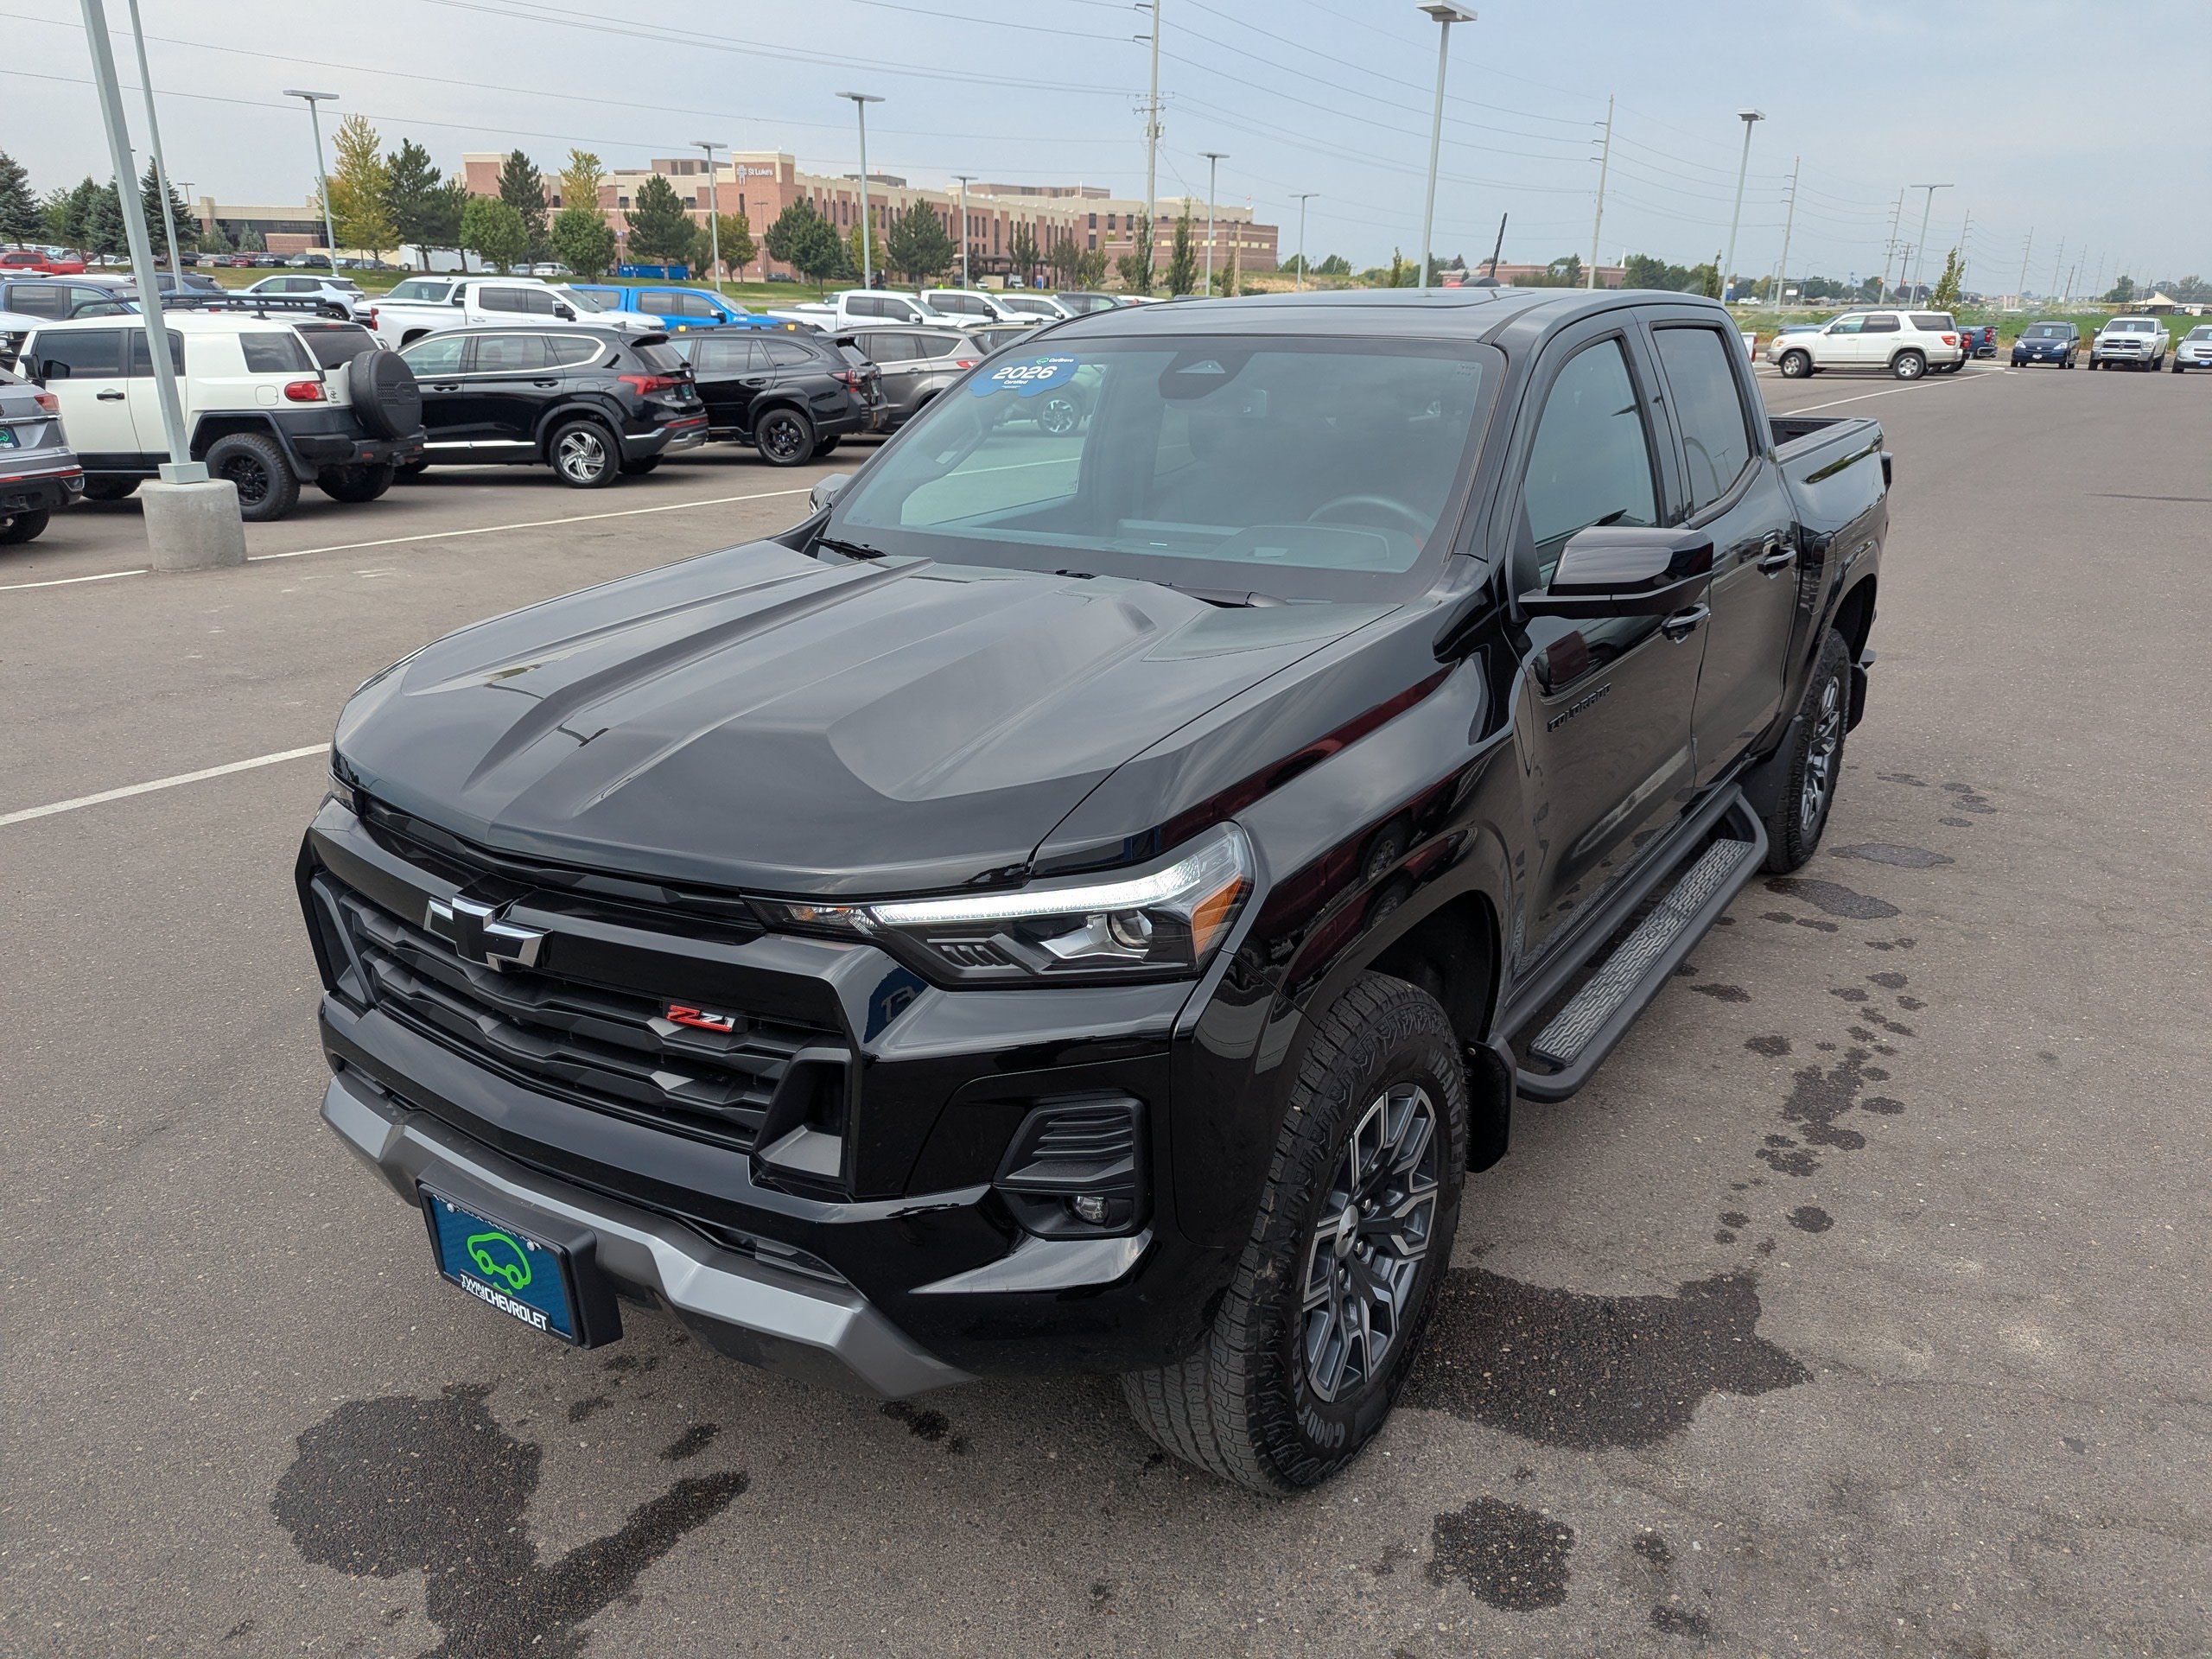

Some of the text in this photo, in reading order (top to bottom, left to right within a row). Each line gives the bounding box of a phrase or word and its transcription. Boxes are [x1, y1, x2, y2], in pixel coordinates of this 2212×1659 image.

[991, 365, 1058, 380] 2026
[666, 1004, 736, 1033] Z71
[1424, 1045, 1464, 1185] WRANGLER
[460, 1273, 485, 1294] TWIN
[461, 1281, 486, 1301] FALLS
[484, 1287, 547, 1332] CHEVROLET
